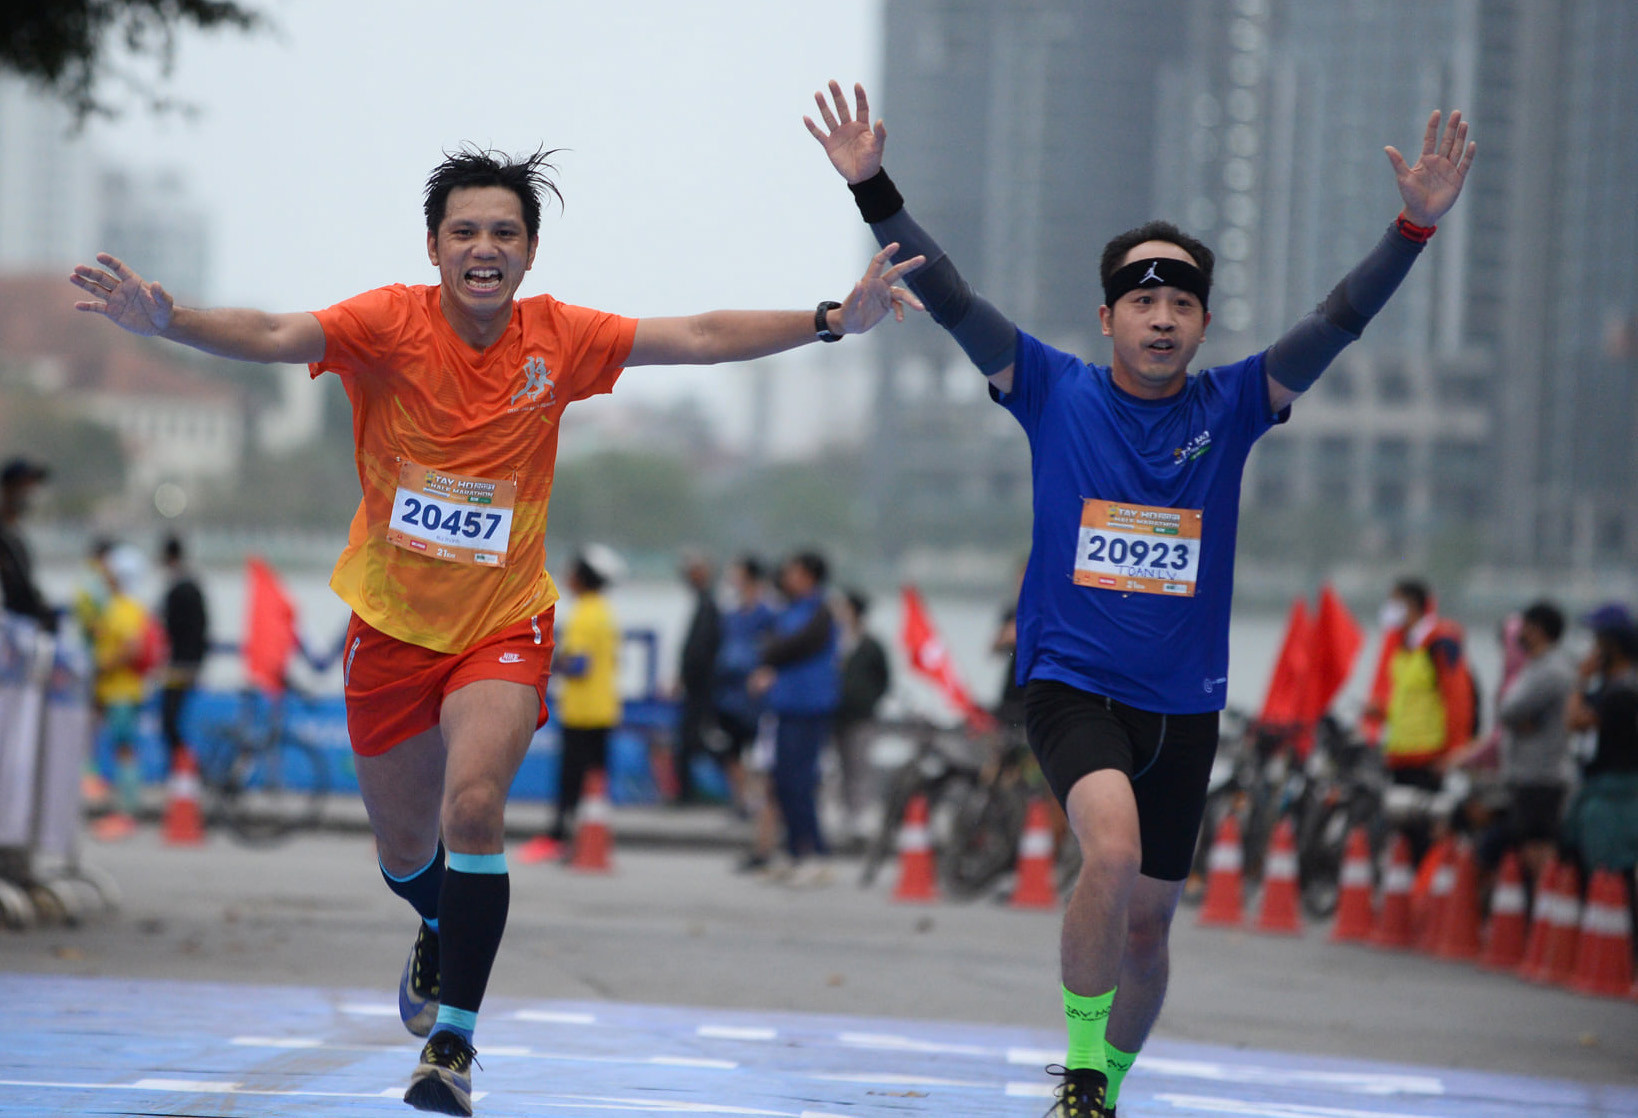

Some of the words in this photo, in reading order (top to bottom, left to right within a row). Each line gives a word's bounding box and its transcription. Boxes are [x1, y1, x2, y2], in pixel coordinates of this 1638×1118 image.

[436, 475, 454, 486] TAY
[431, 482, 451, 492] HALF
[452, 488, 494, 498] MARATHON
[401, 498, 502, 540] 20457
[1118, 508, 1138, 517] TAY
[1087, 535, 1189, 571] 20923
[503, 652, 520, 661] NIKE
